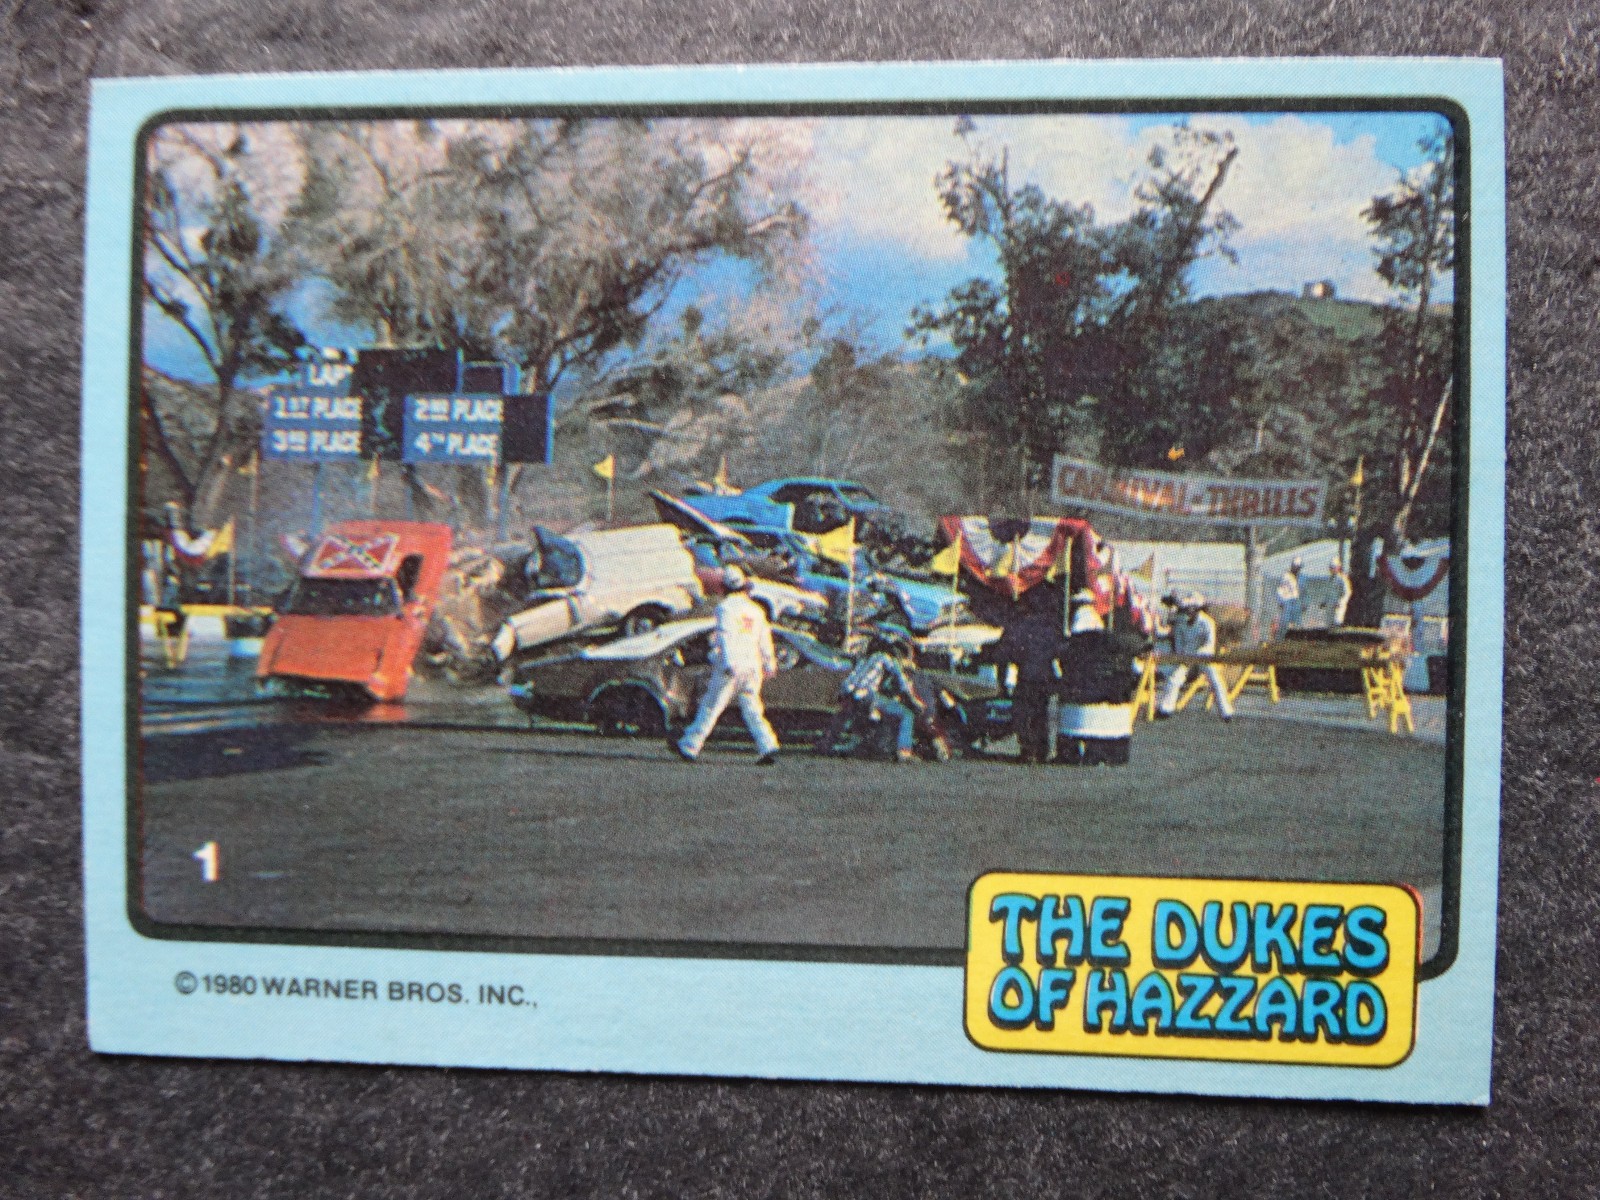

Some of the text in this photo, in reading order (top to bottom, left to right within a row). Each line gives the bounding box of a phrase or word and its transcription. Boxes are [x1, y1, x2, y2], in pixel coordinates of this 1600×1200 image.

[309, 364, 354, 385] LAP
[312, 396, 363, 420] PLACE
[452, 398, 505, 422] PLACE
[311, 430, 362, 453] PLACE
[447, 432, 500, 456] PLACE
[193, 841, 220, 882] 1
[989, 892, 1389, 976] THE DUKES
[262, 976, 378, 1000] WARNER
[388, 980, 469, 1004] BROS.
[987, 965, 1388, 1046] OF HAZZARD
